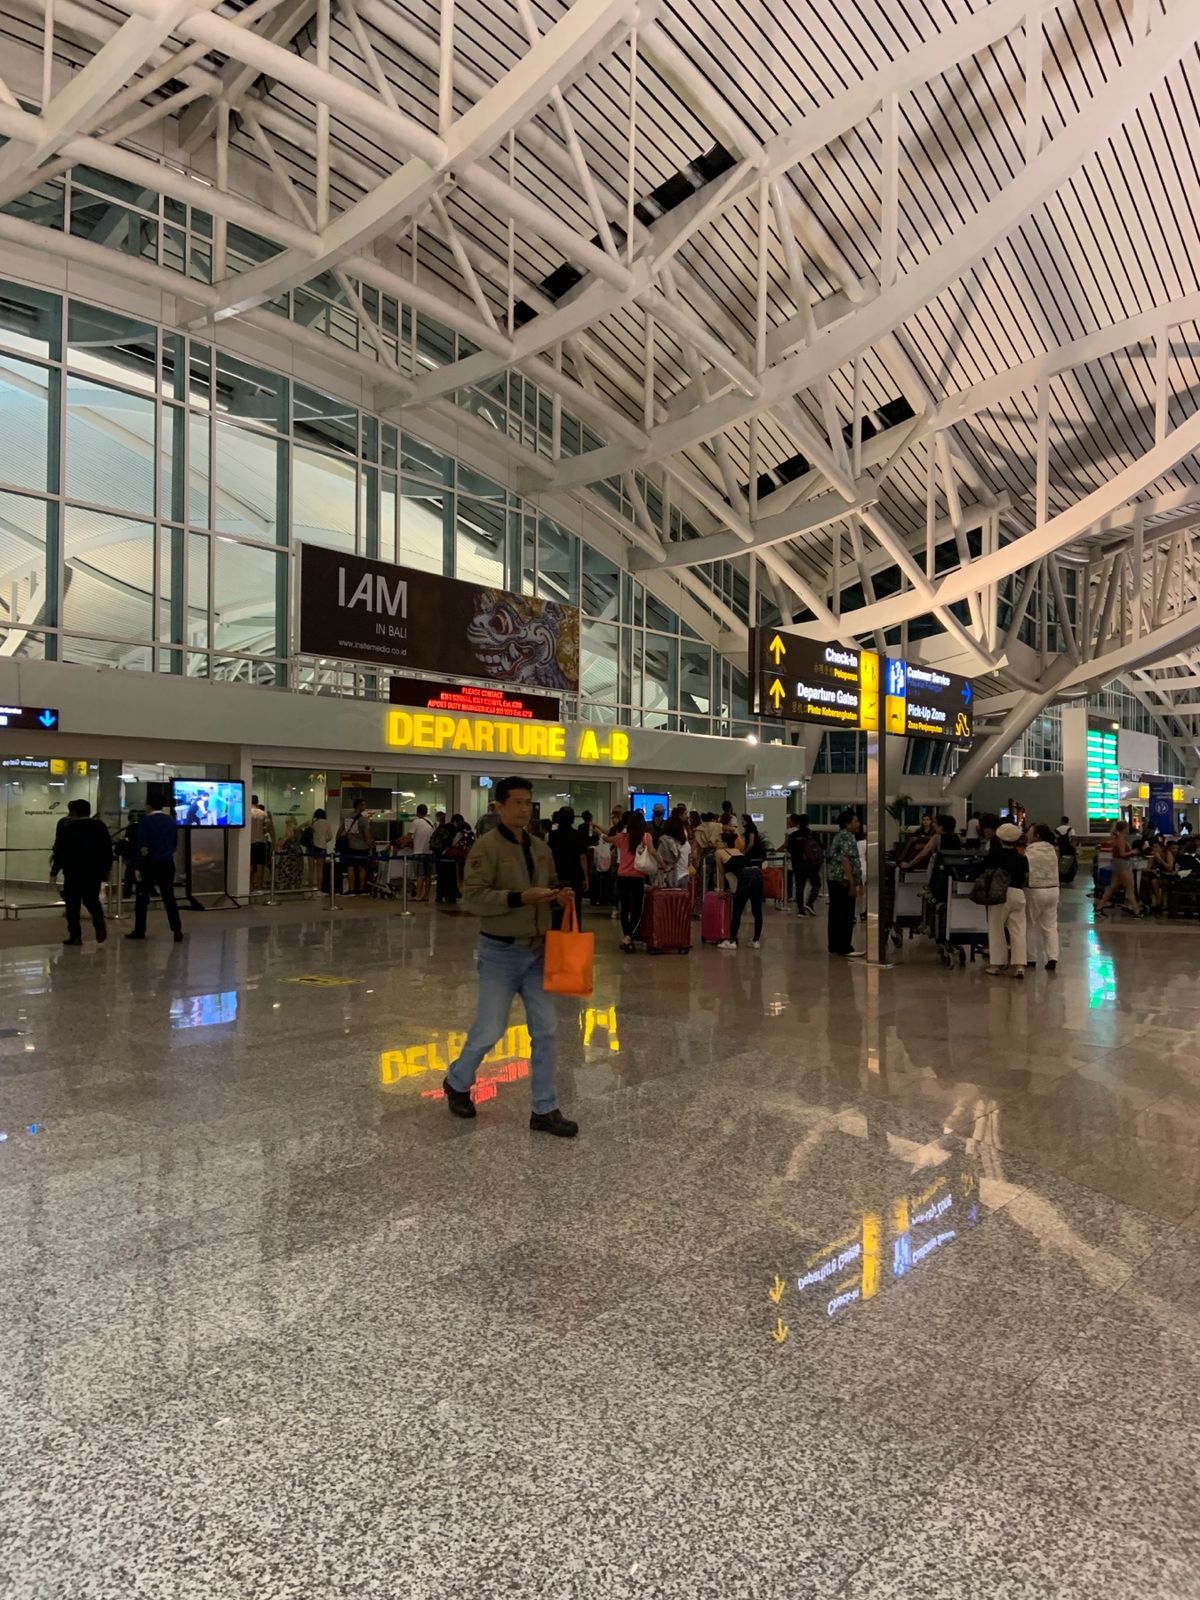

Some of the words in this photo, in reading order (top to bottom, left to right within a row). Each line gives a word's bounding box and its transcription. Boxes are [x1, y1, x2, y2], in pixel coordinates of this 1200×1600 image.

[375, 623, 386, 636] IN
[388, 626, 408, 639] BALI
[907, 666, 931, 683] Customer
[931, 671, 951, 687] Service
[797, 682, 836, 704] Departure
[836, 688, 858, 706] Gates
[908, 703, 930, 721] Pick-Up
[931, 708, 947, 722] Zone
[387, 711, 566, 758] DEPARTURE
[580, 730, 630, 762] A-B
